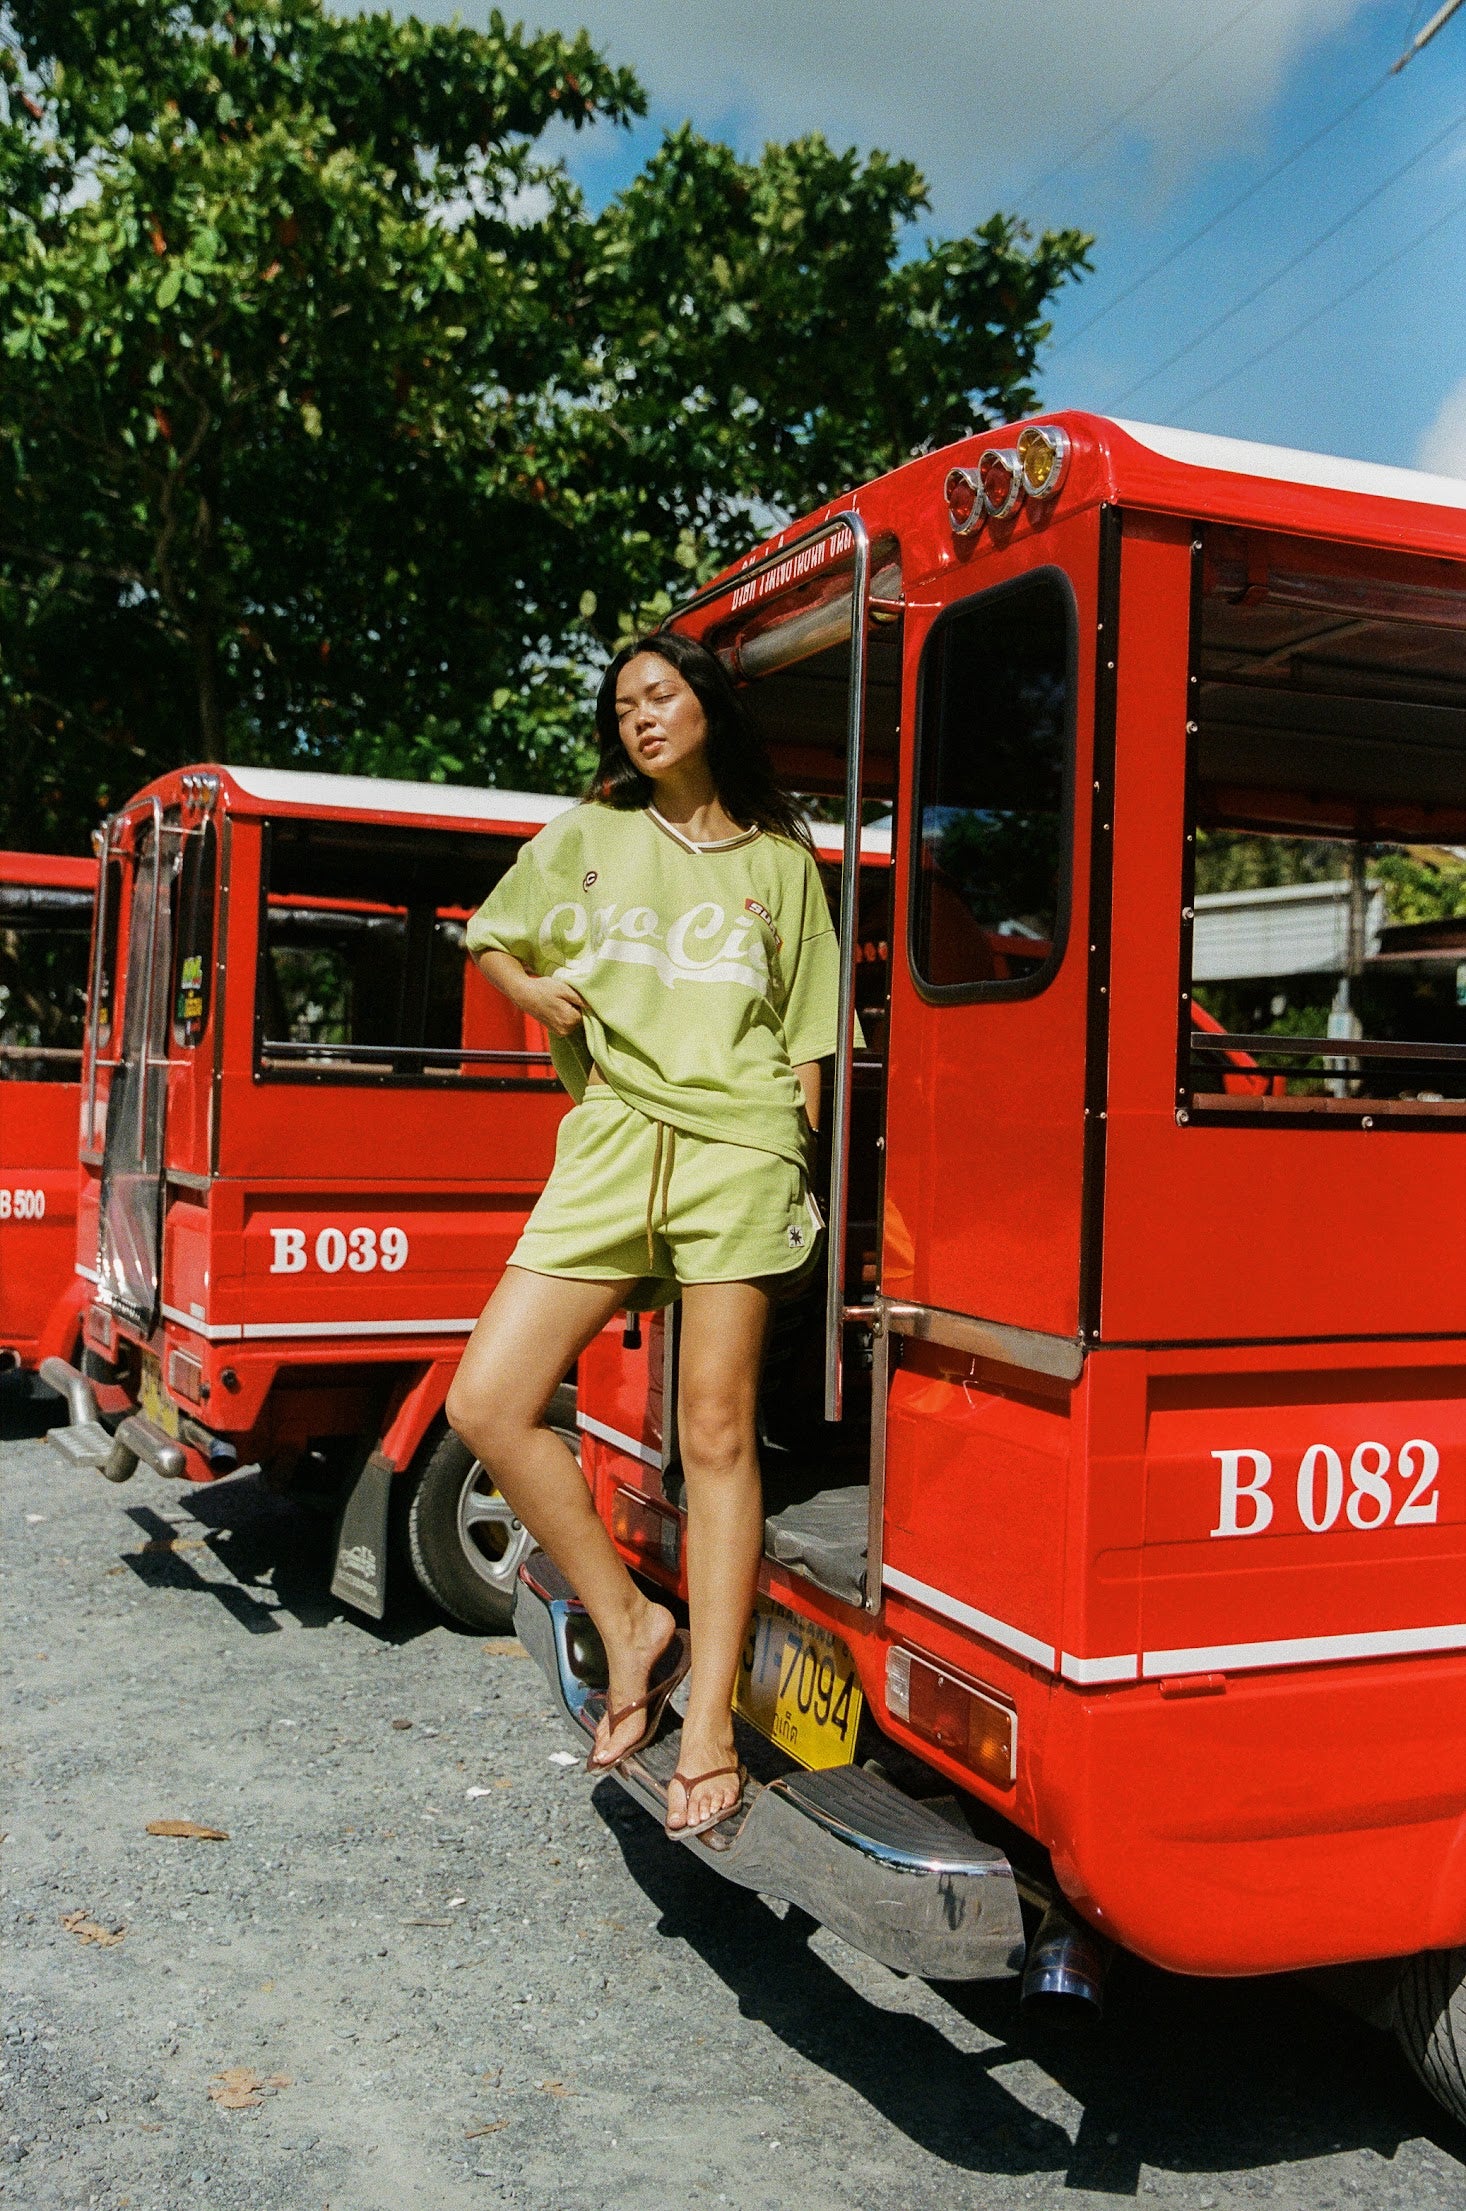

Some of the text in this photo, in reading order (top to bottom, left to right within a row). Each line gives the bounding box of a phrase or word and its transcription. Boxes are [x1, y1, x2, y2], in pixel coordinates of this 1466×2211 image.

[0, 1189, 46, 1220] B 500
[269, 1227, 409, 1274] B 039
[1210, 1438, 1440, 1538] B 082
